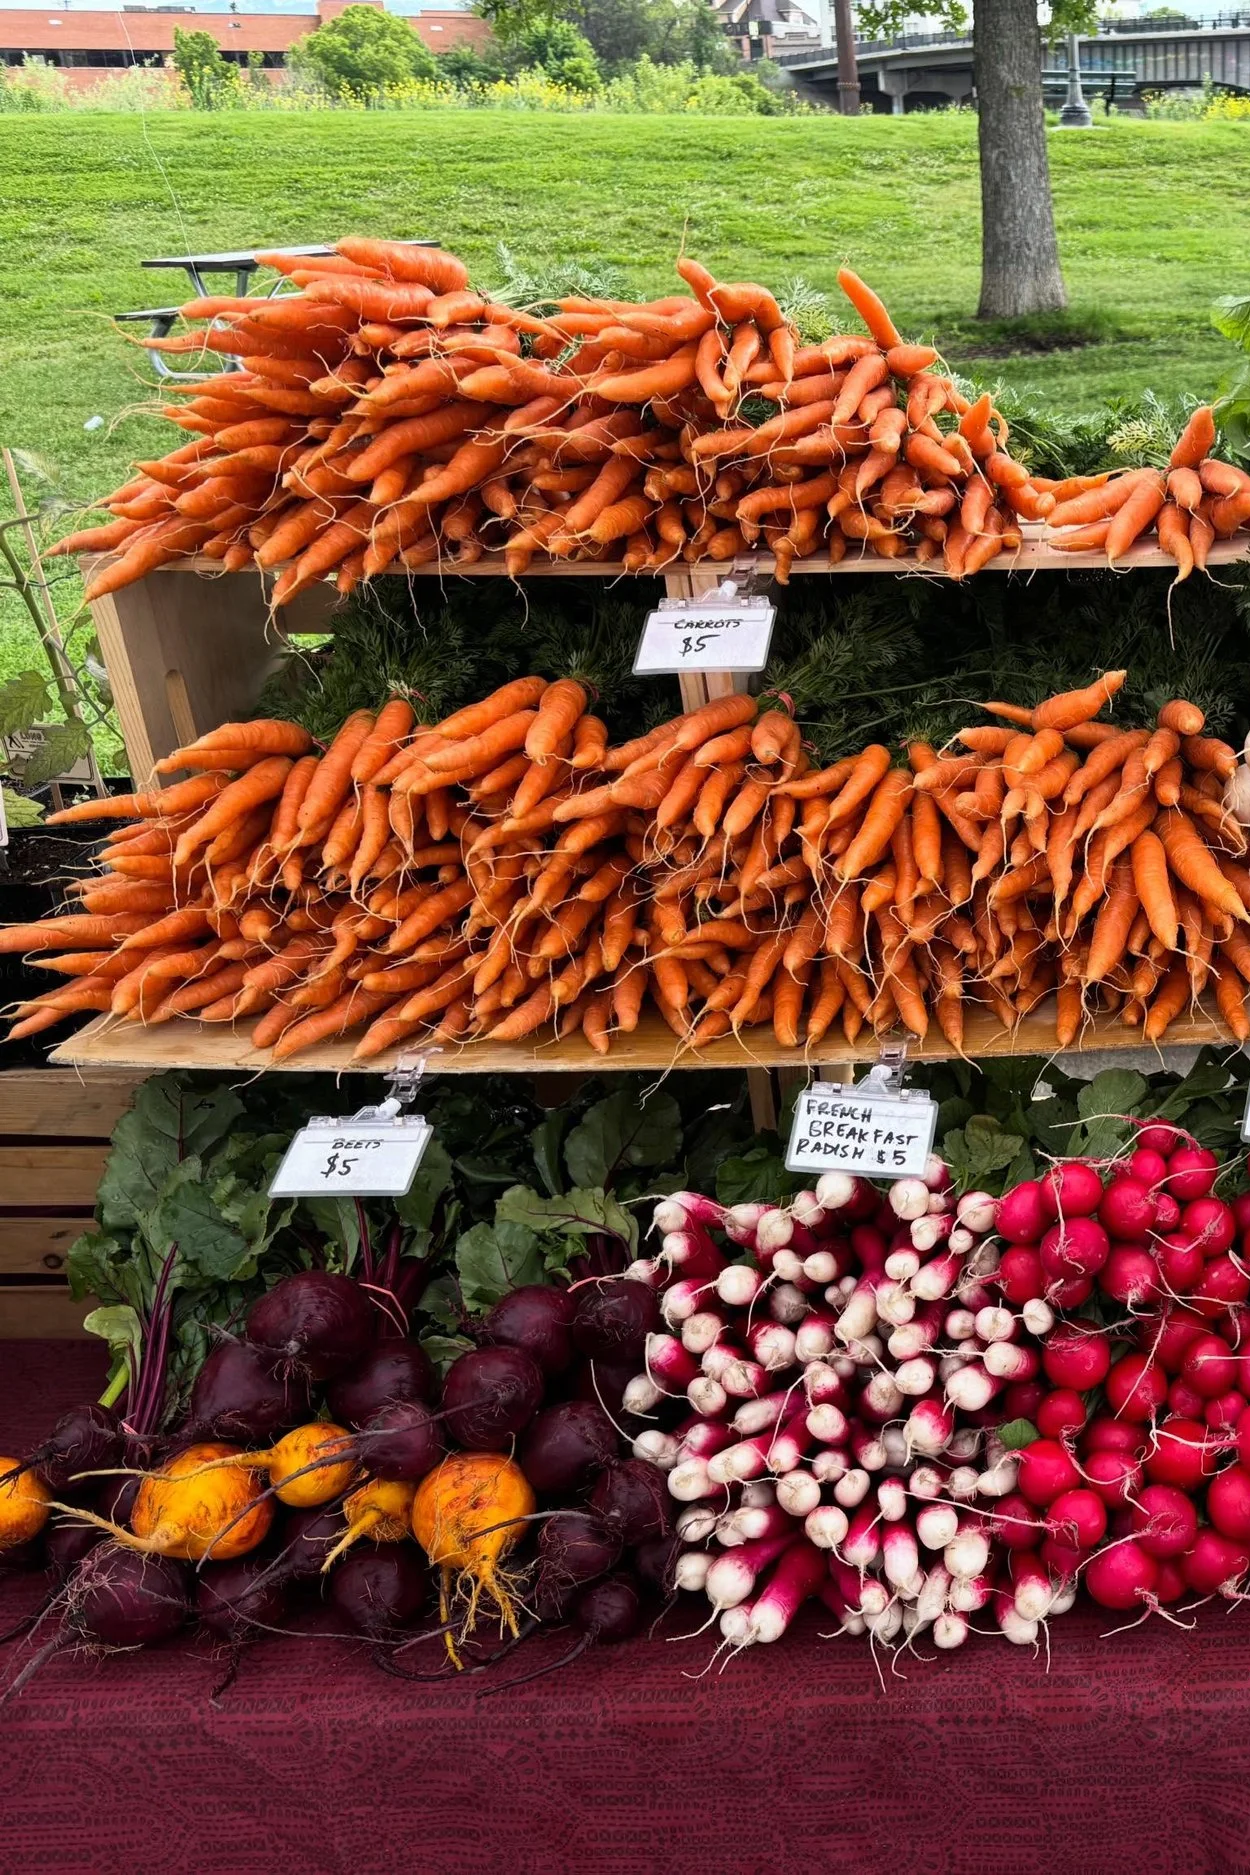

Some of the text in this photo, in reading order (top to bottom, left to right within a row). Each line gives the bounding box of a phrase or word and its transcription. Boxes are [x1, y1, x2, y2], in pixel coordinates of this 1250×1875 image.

[674, 618, 744, 630] CARROTS
[679, 634, 721, 657] $5
[806, 1099, 872, 1123] FRENCH
[332, 1138, 385, 1150] BEETS
[796, 1138, 907, 1166] RADISH $5
[320, 1153, 359, 1178] $5
